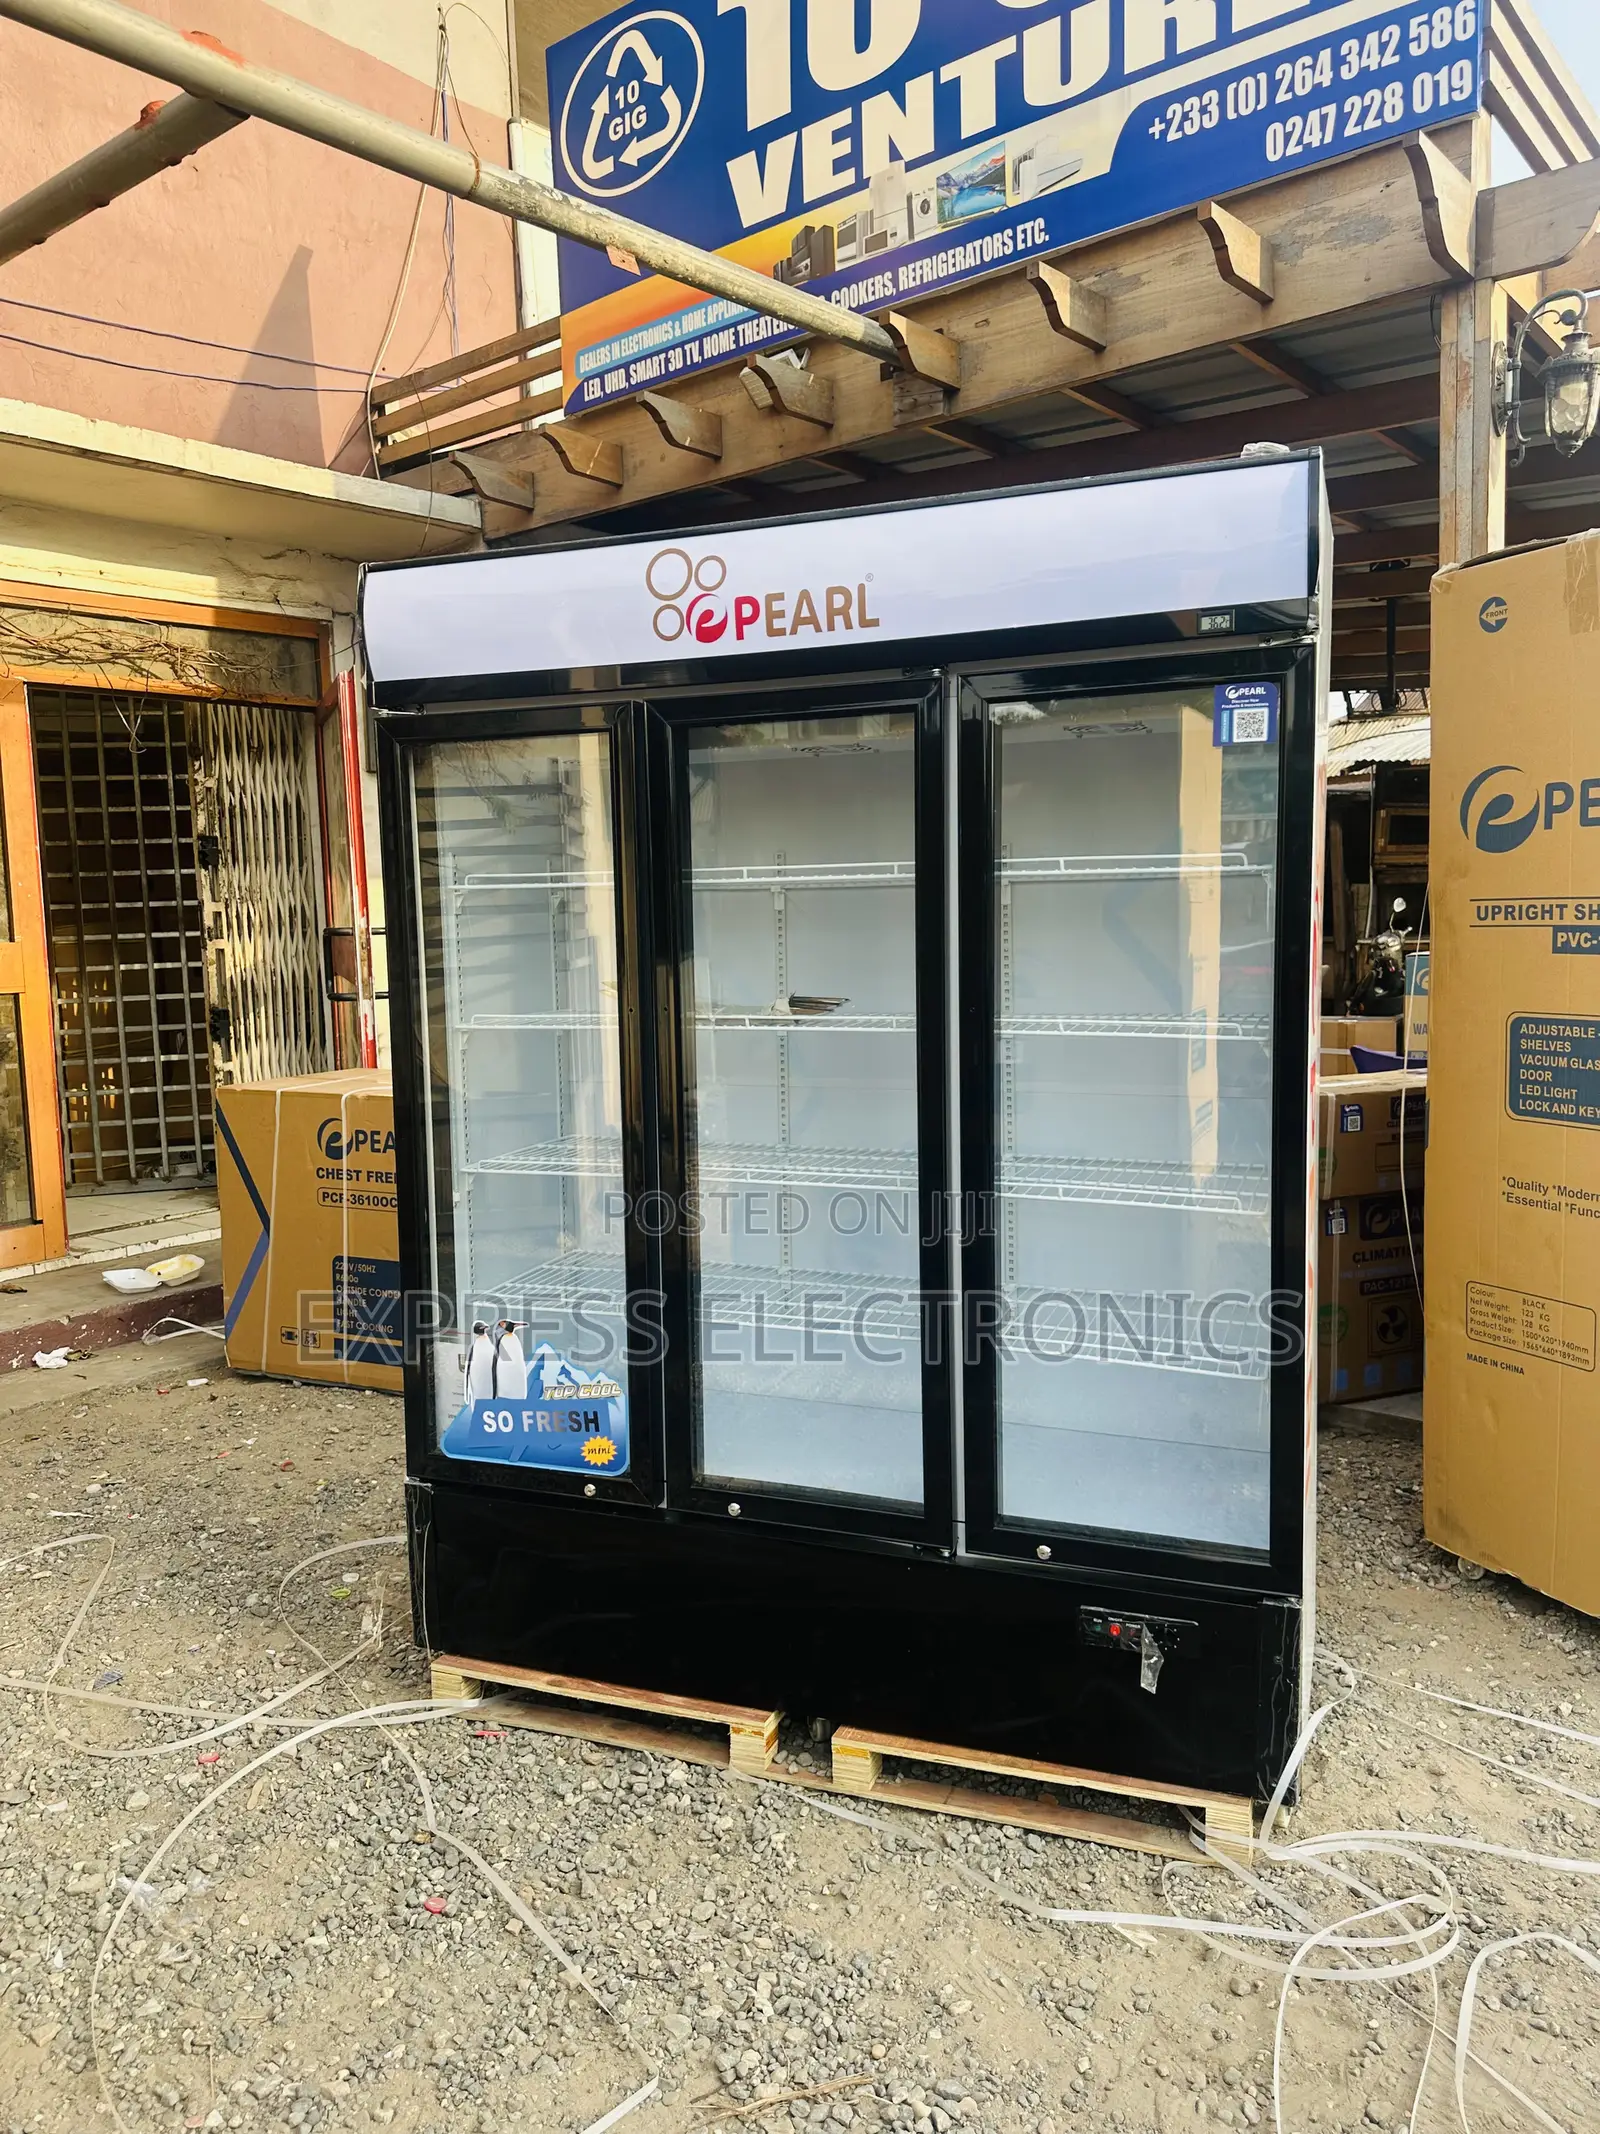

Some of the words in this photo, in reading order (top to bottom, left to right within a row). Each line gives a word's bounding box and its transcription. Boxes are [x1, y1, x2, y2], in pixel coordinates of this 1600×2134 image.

[1149, 89, 1219, 143] +233
[1226, 72, 1268, 120] (0)
[1275, 48, 1333, 104] 264
[1340, 24, 1401, 80] 342
[1409, 0, 1476, 57] 586
[614, 80, 640, 110] 10
[1265, 104, 1337, 163] 0247
[1344, 82, 1403, 138] 228
[1412, 59, 1473, 114] 019
[608, 105, 647, 141] GIG
[584, 377, 604, 403] LED,
[604, 368, 630, 394] UHD,
[629, 353, 667, 386] SMART
[668, 349, 684, 370] 3D
[684, 342, 702, 365] TV,
[703, 331, 736, 358] HOME
[898, 232, 1014, 293] REFRIGERATORS
[1016, 218, 1050, 252] ETC.
[580, 348, 611, 373] DEALERS
[612, 343, 621, 361] IN
[622, 320, 674, 357] ELECTRONICS
[674, 320, 682, 335] &
[682, 309, 707, 335] HOME
[707, 299, 749, 325] APPLIAN
[734, 582, 880, 641] PEARL
[1485, 608, 1509, 619] FRONT
[1239, 686, 1266, 695] PEARL
[1476, 904, 1568, 922] UPRIGHT
[1556, 931, 1600, 948] PVC-
[1520, 1023, 1596, 1039] ADJUSTABLE
[1520, 1038, 1572, 1053] SHELVES
[1520, 1053, 1568, 1068] VACUUM
[1520, 1068, 1552, 1082] DOOR
[1520, 1084, 1541, 1096] LED
[1544, 1086, 1578, 1100] LIGHT
[1520, 1099, 1550, 1113] LOCK
[1552, 1103, 1576, 1115] AND
[316, 1166, 362, 1182] CHEST
[335, 1262, 376, 1274] 22V/50HZ
[1470, 1286, 1496, 1299] Colour:
[1470, 1297, 1483, 1306] Net
[1484, 1300, 1511, 1313] Weight:
[1521, 1308, 1534, 1318] 123
[1540, 1313, 1550, 1322] KG
[1522, 1298, 1546, 1310] BLACK
[356, 1322, 394, 1334] COOLING
[1470, 1307, 1490, 1318] Gross
[1521, 1318, 1534, 1329] 128
[1538, 1324, 1550, 1333] KG
[1470, 1318, 1500, 1330] Product
[1470, 1328, 1502, 1342] Package
[1466, 1352, 1488, 1365] MADE
[1490, 1358, 1498, 1368] IN
[1500, 1362, 1525, 1376] CHINA
[544, 1384, 577, 1401] TOP
[577, 1382, 622, 1400] COOL
[482, 1410, 514, 1433] SO
[522, 1410, 600, 1433] FRESH
[586, 1444, 612, 1456] mini
